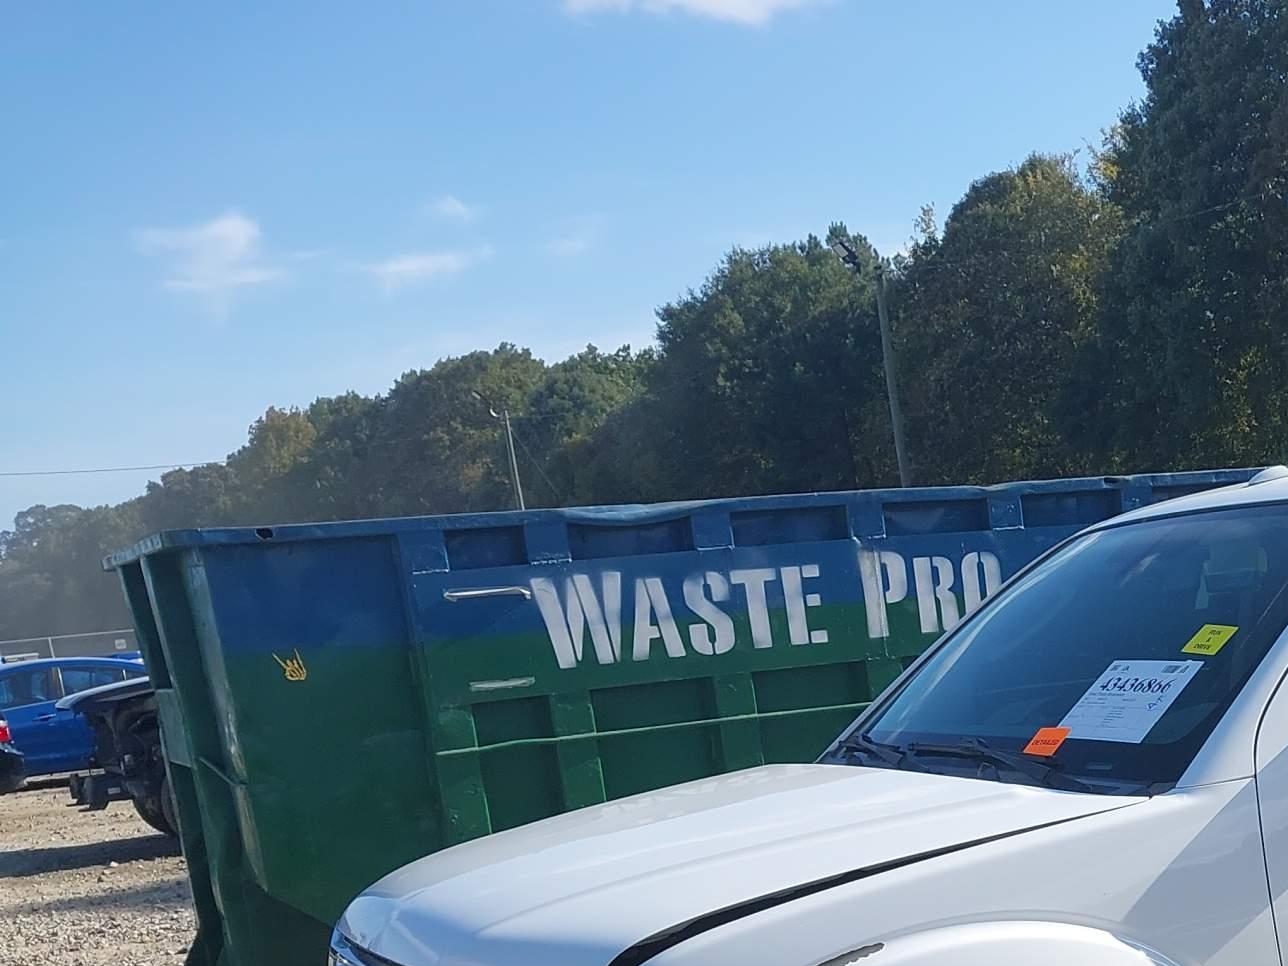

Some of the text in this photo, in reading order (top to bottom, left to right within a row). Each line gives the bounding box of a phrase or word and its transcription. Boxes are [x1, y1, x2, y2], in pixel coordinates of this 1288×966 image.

[530, 551, 1003, 669] WASTE PRO
[1100, 676, 1177, 694] 43436866
